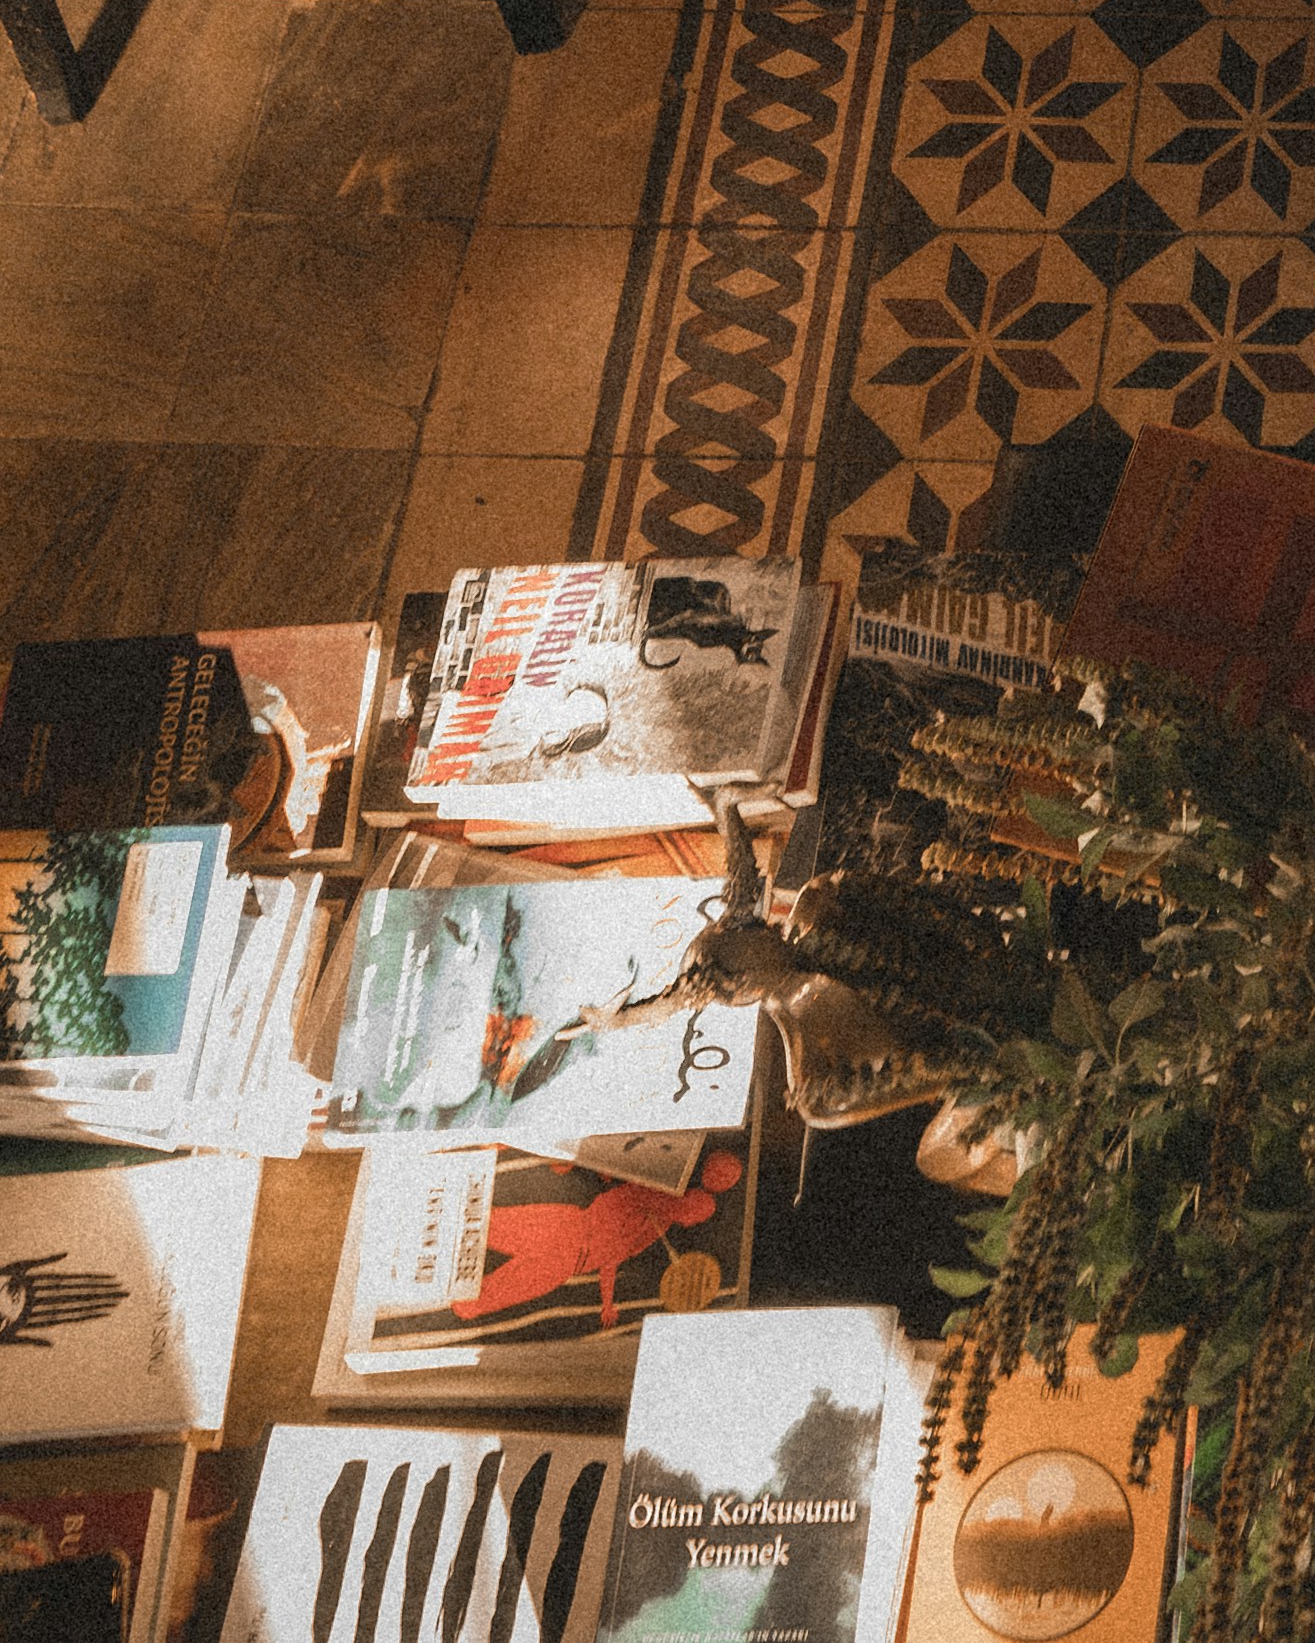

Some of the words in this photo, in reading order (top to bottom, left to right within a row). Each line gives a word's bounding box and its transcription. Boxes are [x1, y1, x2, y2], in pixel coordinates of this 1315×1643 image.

[485, 570, 560, 645] NEIL
[522, 566, 605, 688] KORALİN
[956, 642, 1048, 689] KANDİNAV
[144, 655, 190, 825] ANTROPOLOJİS
[180, 653, 216, 782] GELECEĞİN
[419, 655, 520, 785] GAIMAN
[628, 1493, 703, 1530] Ölüm
[710, 1496, 857, 1528] Korkusunu
[685, 1534, 790, 1569] Yenmek
